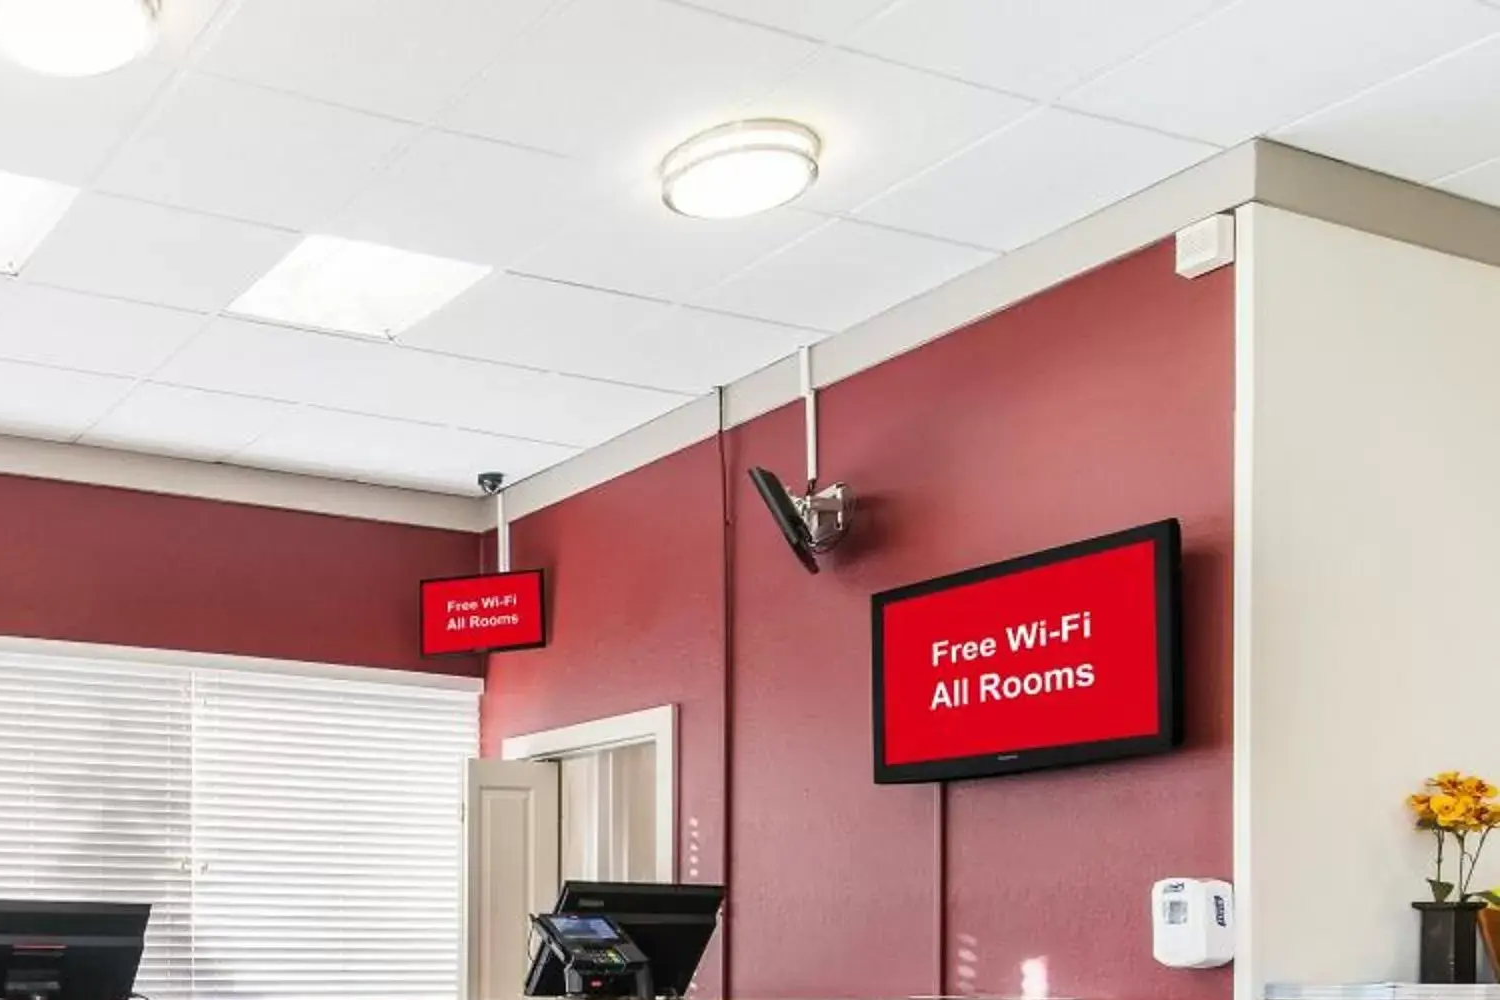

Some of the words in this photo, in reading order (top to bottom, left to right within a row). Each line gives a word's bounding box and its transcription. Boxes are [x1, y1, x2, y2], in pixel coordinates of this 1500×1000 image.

[446, 617, 466, 631] All
[469, 612, 519, 629] Rooms
[447, 600, 479, 614] Free
[931, 637, 997, 667] Free
[1006, 611, 1092, 652] Wi-Fi
[929, 677, 969, 711] All
[979, 662, 1095, 704] Rooms
